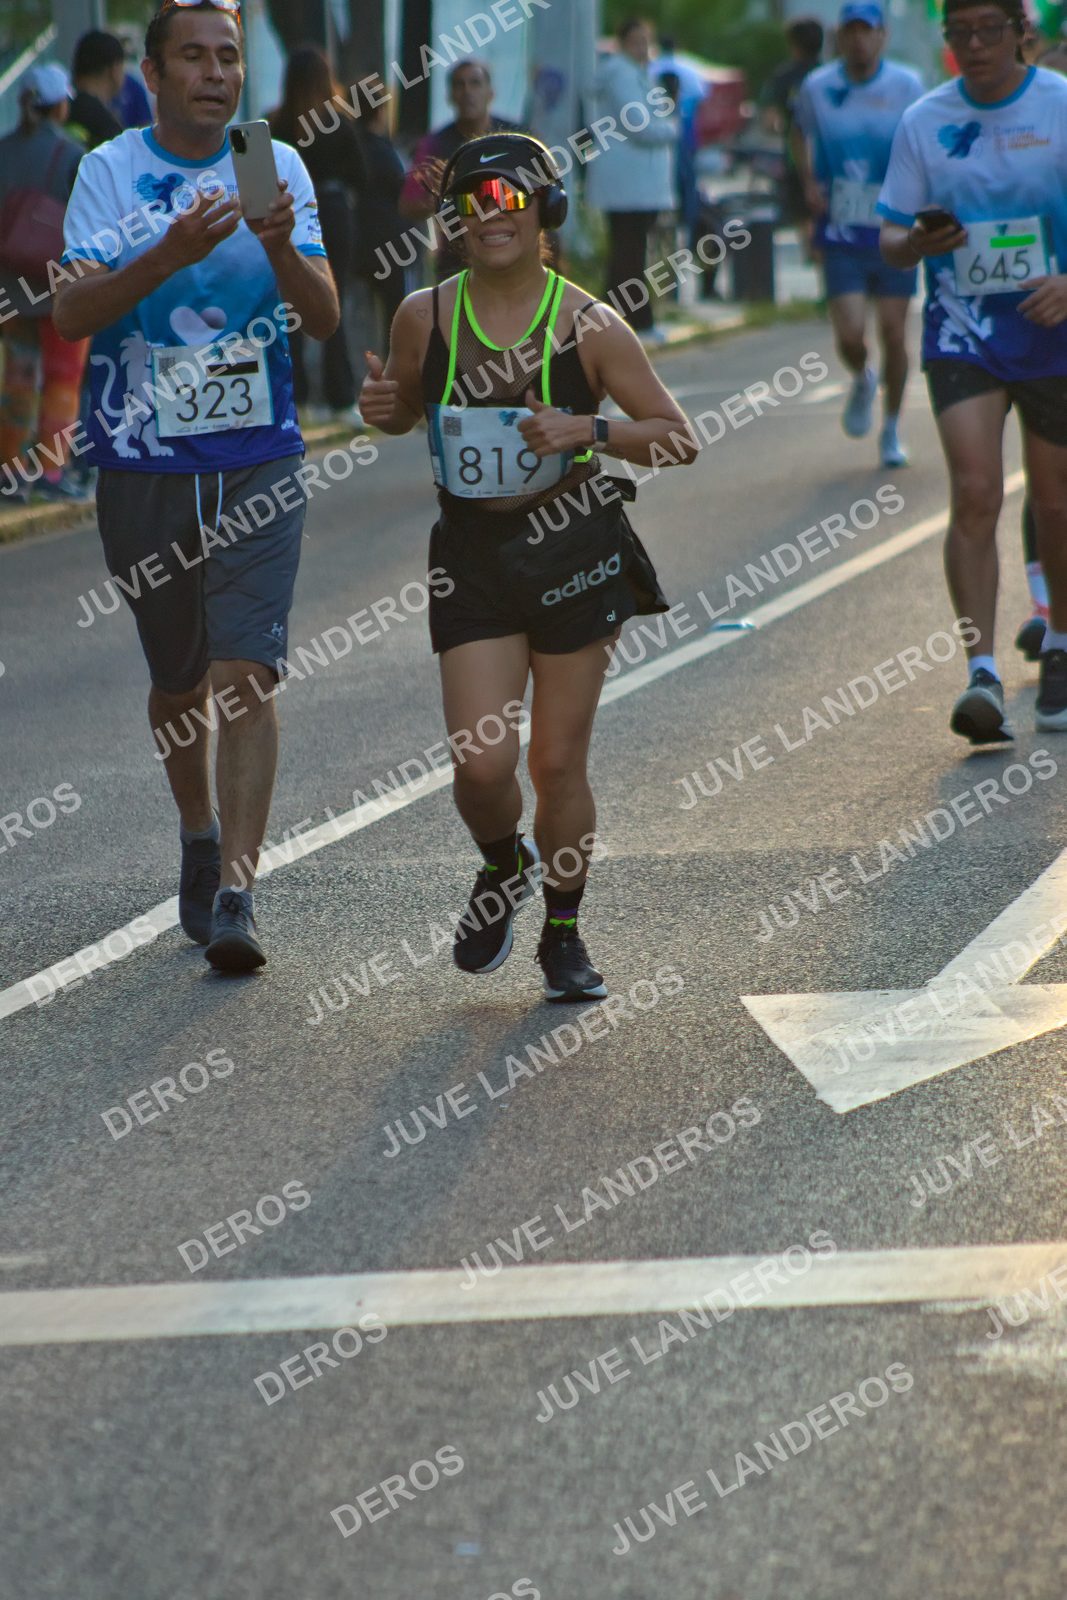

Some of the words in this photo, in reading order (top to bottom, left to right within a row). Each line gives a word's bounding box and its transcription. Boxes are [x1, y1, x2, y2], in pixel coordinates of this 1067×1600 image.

[968, 249, 1031, 285] 645
[175, 377, 253, 423] 323
[459, 446, 542, 486] 819
